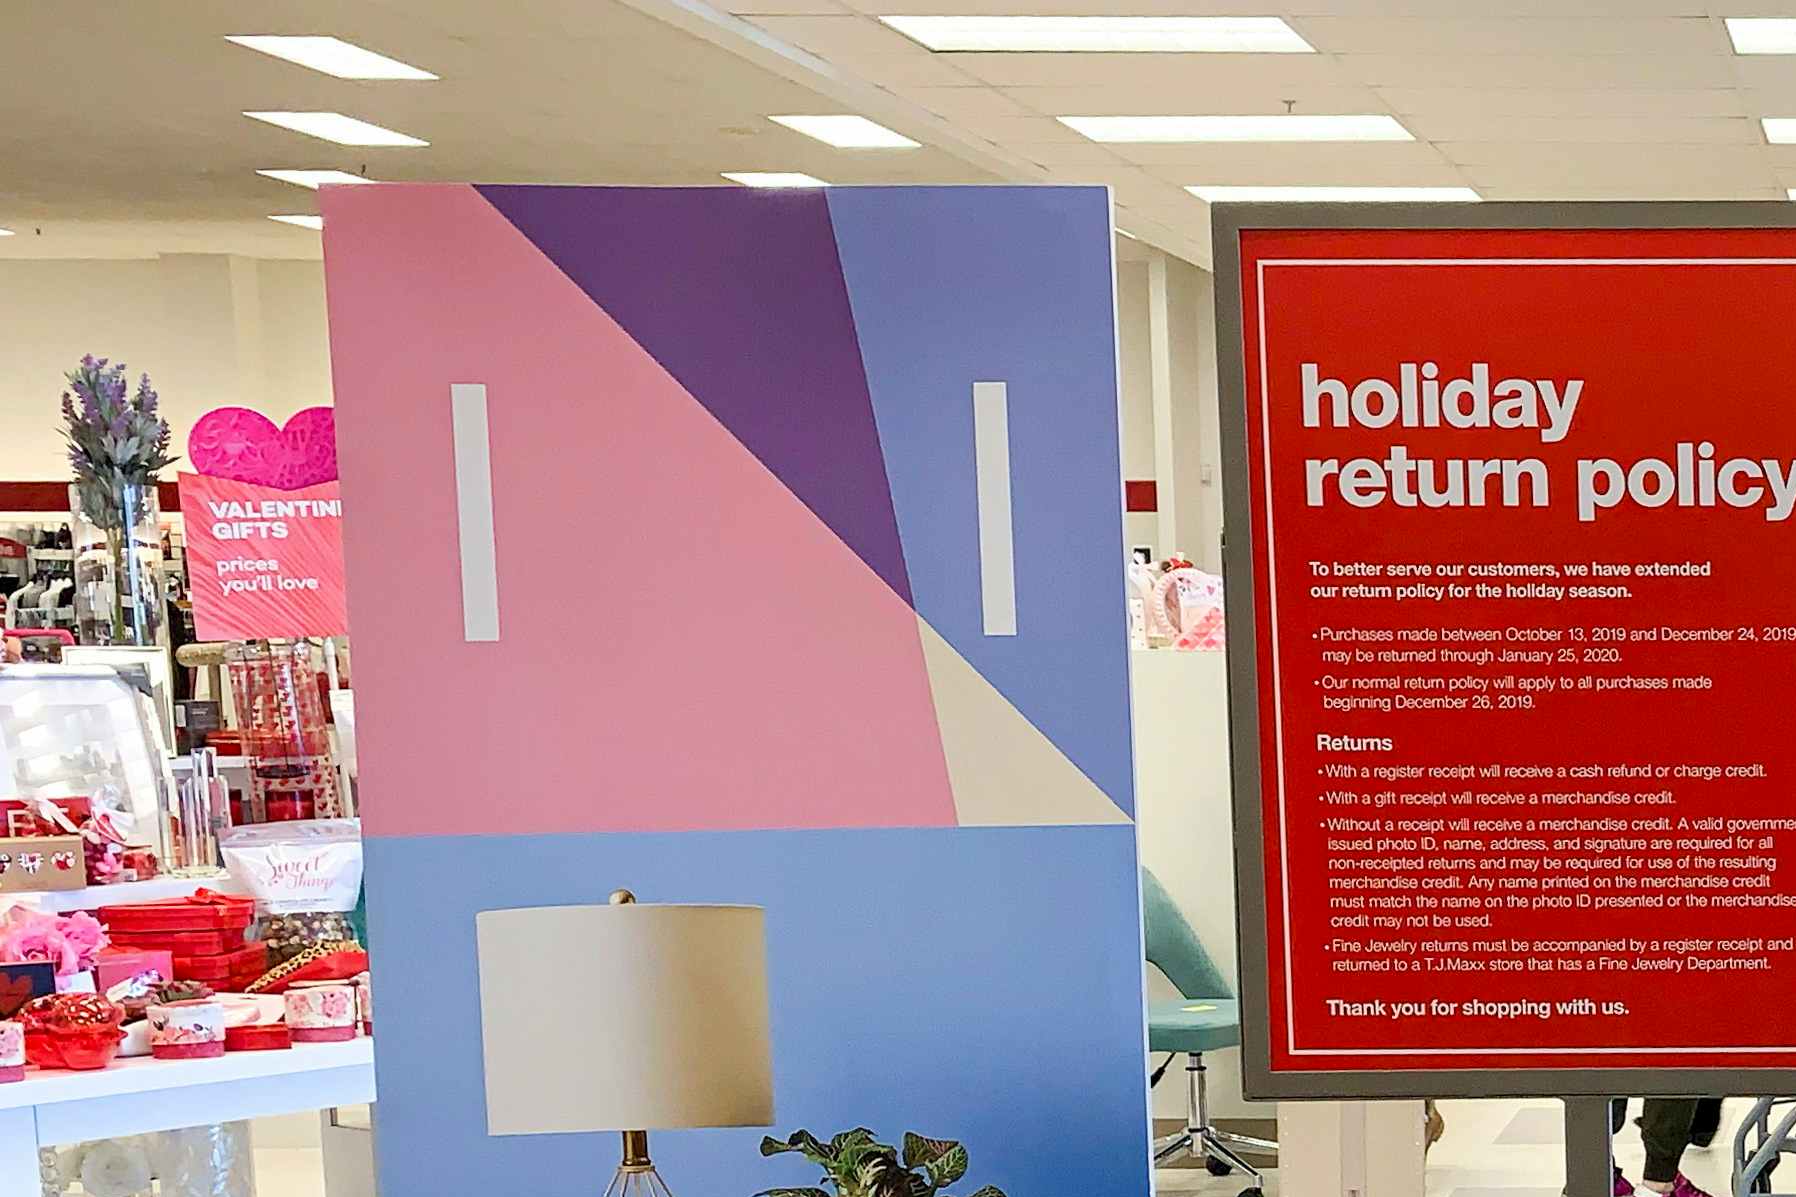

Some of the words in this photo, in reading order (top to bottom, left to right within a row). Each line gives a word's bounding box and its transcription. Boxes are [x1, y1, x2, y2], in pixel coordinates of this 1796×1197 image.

[1301, 362, 1585, 444] holiday
[1305, 445, 1549, 508] return
[207, 499, 342, 519] VALENTIN
[211, 520, 289, 540] GIFTS
[215, 555, 279, 577] prices
[1308, 561, 1330, 577] To
[1332, 561, 1384, 577] better
[1386, 564, 1432, 577] serve
[1435, 564, 1465, 578] our
[1467, 561, 1561, 579] customers,
[1563, 564, 1589, 577] we
[1591, 561, 1632, 577] have
[1634, 560, 1712, 577] extended
[218, 574, 273, 597] you'll
[276, 574, 319, 591] love
[1310, 586, 1340, 598] our
[1341, 583, 1393, 598] return
[1396, 582, 1445, 601] policy
[1447, 582, 1473, 599] for
[1474, 582, 1503, 598] the
[1505, 582, 1566, 601] holiday
[1568, 586, 1633, 599] season.
[1320, 626, 1394, 642] Purchases
[1397, 627, 1438, 642] made
[1441, 626, 1502, 642] between
[1505, 626, 1563, 642] October
[1567, 627, 1588, 642] 13,
[1591, 627, 1627, 642] 2019
[1629, 627, 1657, 642] and
[1660, 626, 1735, 642] December
[1737, 627, 1759, 642] 24,
[1322, 650, 1353, 666] may
[1355, 648, 1375, 663] be
[1377, 648, 1437, 663] returned
[1440, 647, 1494, 666] through
[1497, 648, 1554, 666] January
[1557, 647, 1579, 664] 25,
[1583, 647, 1623, 663] 2020.
[1321, 674, 1349, 690] Our
[1351, 675, 1401, 690] normal
[1404, 676, 1445, 690] return
[1448, 675, 1489, 693] policy
[1492, 675, 1515, 689] will
[1517, 675, 1557, 693] apply
[1559, 676, 1574, 690] to
[1577, 675, 1593, 690] all
[1596, 675, 1669, 692] purchases
[1672, 675, 1713, 689] made
[1323, 695, 1392, 712] beginning
[1394, 694, 1469, 710] December
[1471, 694, 1494, 710] 26,
[1497, 694, 1536, 709] 2019.
[1316, 733, 1393, 752] Returns
[1324, 763, 1357, 779] With
[1360, 766, 1370, 778] a
[1373, 764, 1425, 782] register
[1428, 765, 1476, 782] receipt
[1478, 764, 1501, 778] will
[1504, 764, 1554, 778] receive
[1556, 766, 1567, 778] a
[1569, 763, 1604, 778] cash
[1607, 763, 1652, 778] refund
[1654, 766, 1671, 778] or
[1673, 764, 1722, 781] charge
[1724, 763, 1768, 778] credit.
[1326, 817, 1381, 832] Without
[1384, 820, 1394, 832] a
[1397, 818, 1445, 834] receipt
[1447, 817, 1470, 831] will
[1473, 818, 1523, 832] receive
[1525, 819, 1536, 832] a
[1539, 817, 1628, 832] merchandise
[1631, 816, 1674, 831] credit.
[1677, 816, 1690, 831] A
[1691, 816, 1724, 831] valid
[1327, 836, 1374, 851] issued
[1376, 837, 1418, 853] photo
[1420, 836, 1439, 851] ID,
[1443, 838, 1486, 852] name,
[1489, 836, 1550, 851] address,
[1553, 836, 1581, 851] and
[1583, 837, 1647, 854] signature
[1650, 838, 1674, 850] are
[1676, 835, 1733, 852] required
[1736, 835, 1755, 850] for
[1758, 836, 1774, 850] all
[1328, 856, 1425, 873] non-receipted
[1427, 857, 1477, 871] returns
[1479, 856, 1507, 870] and
[1509, 858, 1540, 873] may
[1542, 856, 1562, 870] be
[1565, 855, 1622, 872] required
[1625, 855, 1645, 869] for
[1647, 857, 1673, 870] use
[1676, 854, 1690, 870] of
[1693, 855, 1717, 869] the
[1718, 855, 1777, 872] resulting
[1332, 938, 1362, 953] Fine
[1364, 938, 1418, 955] Jewelry
[1420, 939, 1470, 954] returns
[1472, 939, 1507, 953] must
[1510, 938, 1530, 952] be
[1532, 937, 1626, 955] accompanied
[1629, 938, 1648, 955] by
[1650, 940, 1660, 952] a
[1663, 938, 1714, 955] register
[1716, 937, 1764, 954] receipt
[1766, 938, 1794, 952] and
[1332, 958, 1390, 972] returned
[1393, 958, 1408, 972] to
[1410, 960, 1421, 972] a
[1423, 956, 1486, 971] T.J.Maxx
[1489, 958, 1524, 972] store
[1526, 957, 1554, 971] that
[1557, 957, 1583, 971] has
[1586, 959, 1596, 971] a
[1599, 956, 1628, 971] Fine
[1631, 956, 1684, 973] Jewelry
[1687, 955, 1772, 973] Department.
[1325, 999, 1387, 1017] Thank
[1390, 1002, 1426, 1020] you
[1429, 998, 1459, 1017] for
[1461, 998, 1551, 1019] shopping
[1555, 997, 1597, 1016] with
[1601, 1001, 1630, 1016] us.
